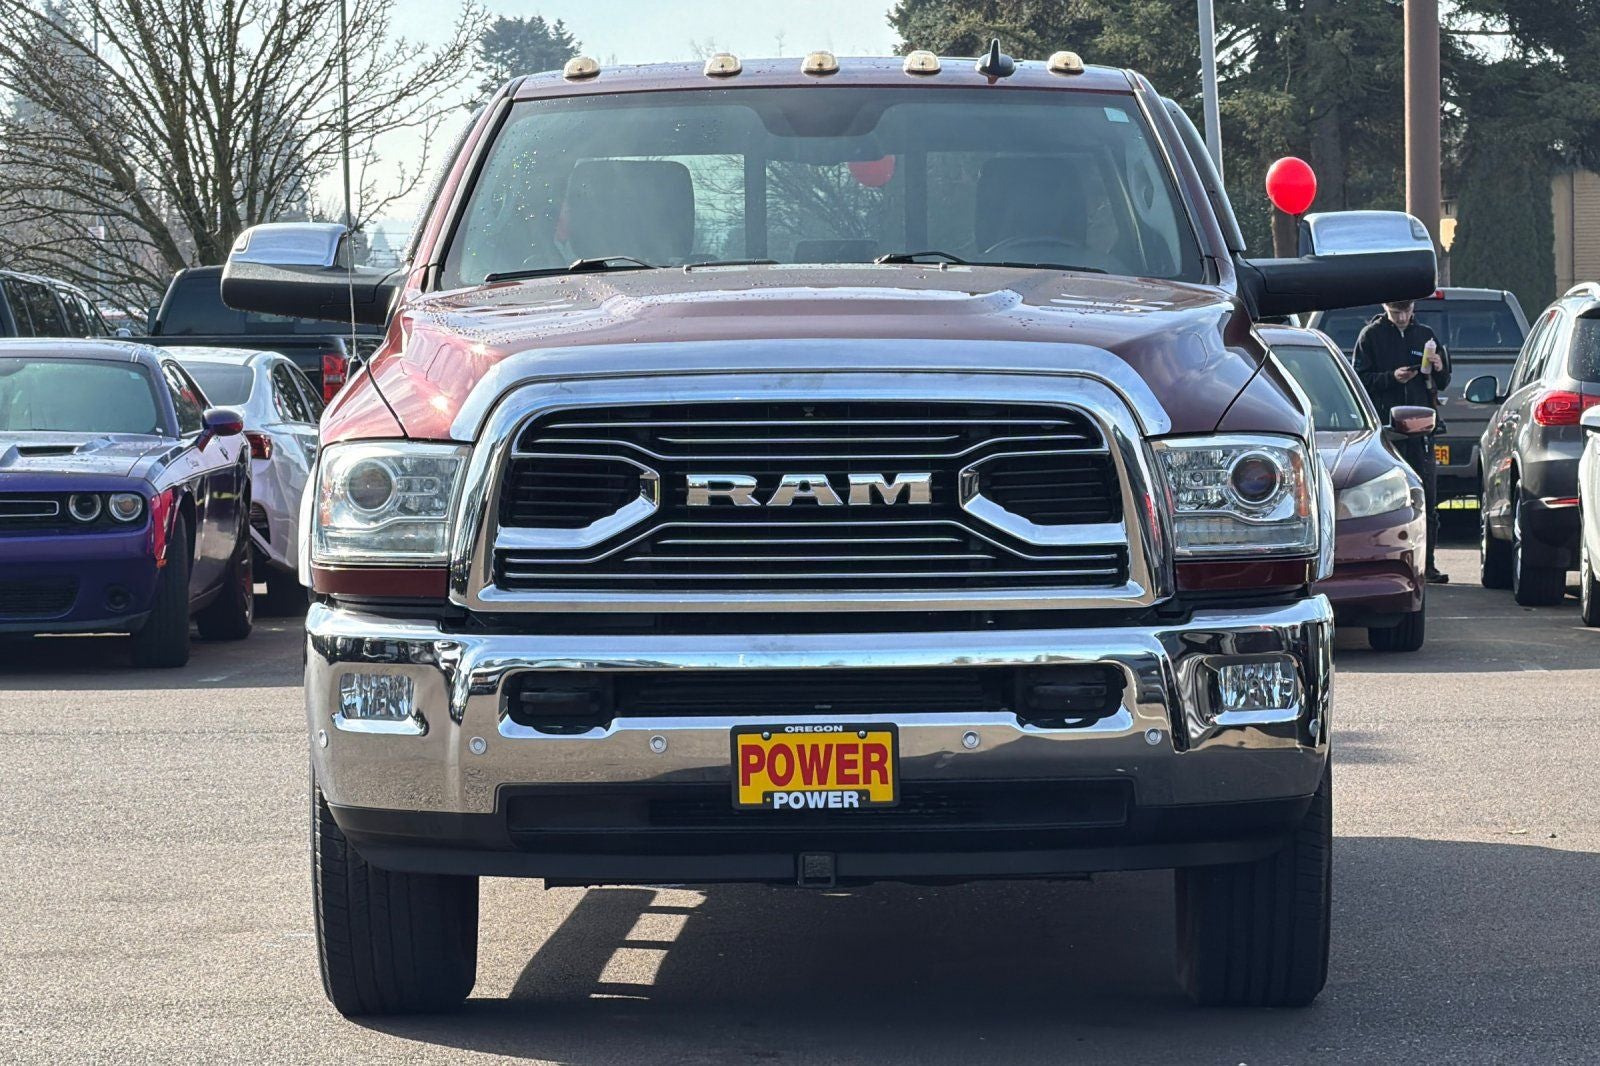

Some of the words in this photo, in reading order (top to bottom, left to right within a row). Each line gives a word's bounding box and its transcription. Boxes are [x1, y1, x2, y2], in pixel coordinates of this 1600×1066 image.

[686, 473, 932, 506] RAM
[784, 725, 844, 733] OREGON
[741, 743, 889, 787] POWER
[773, 791, 860, 809] POWER
